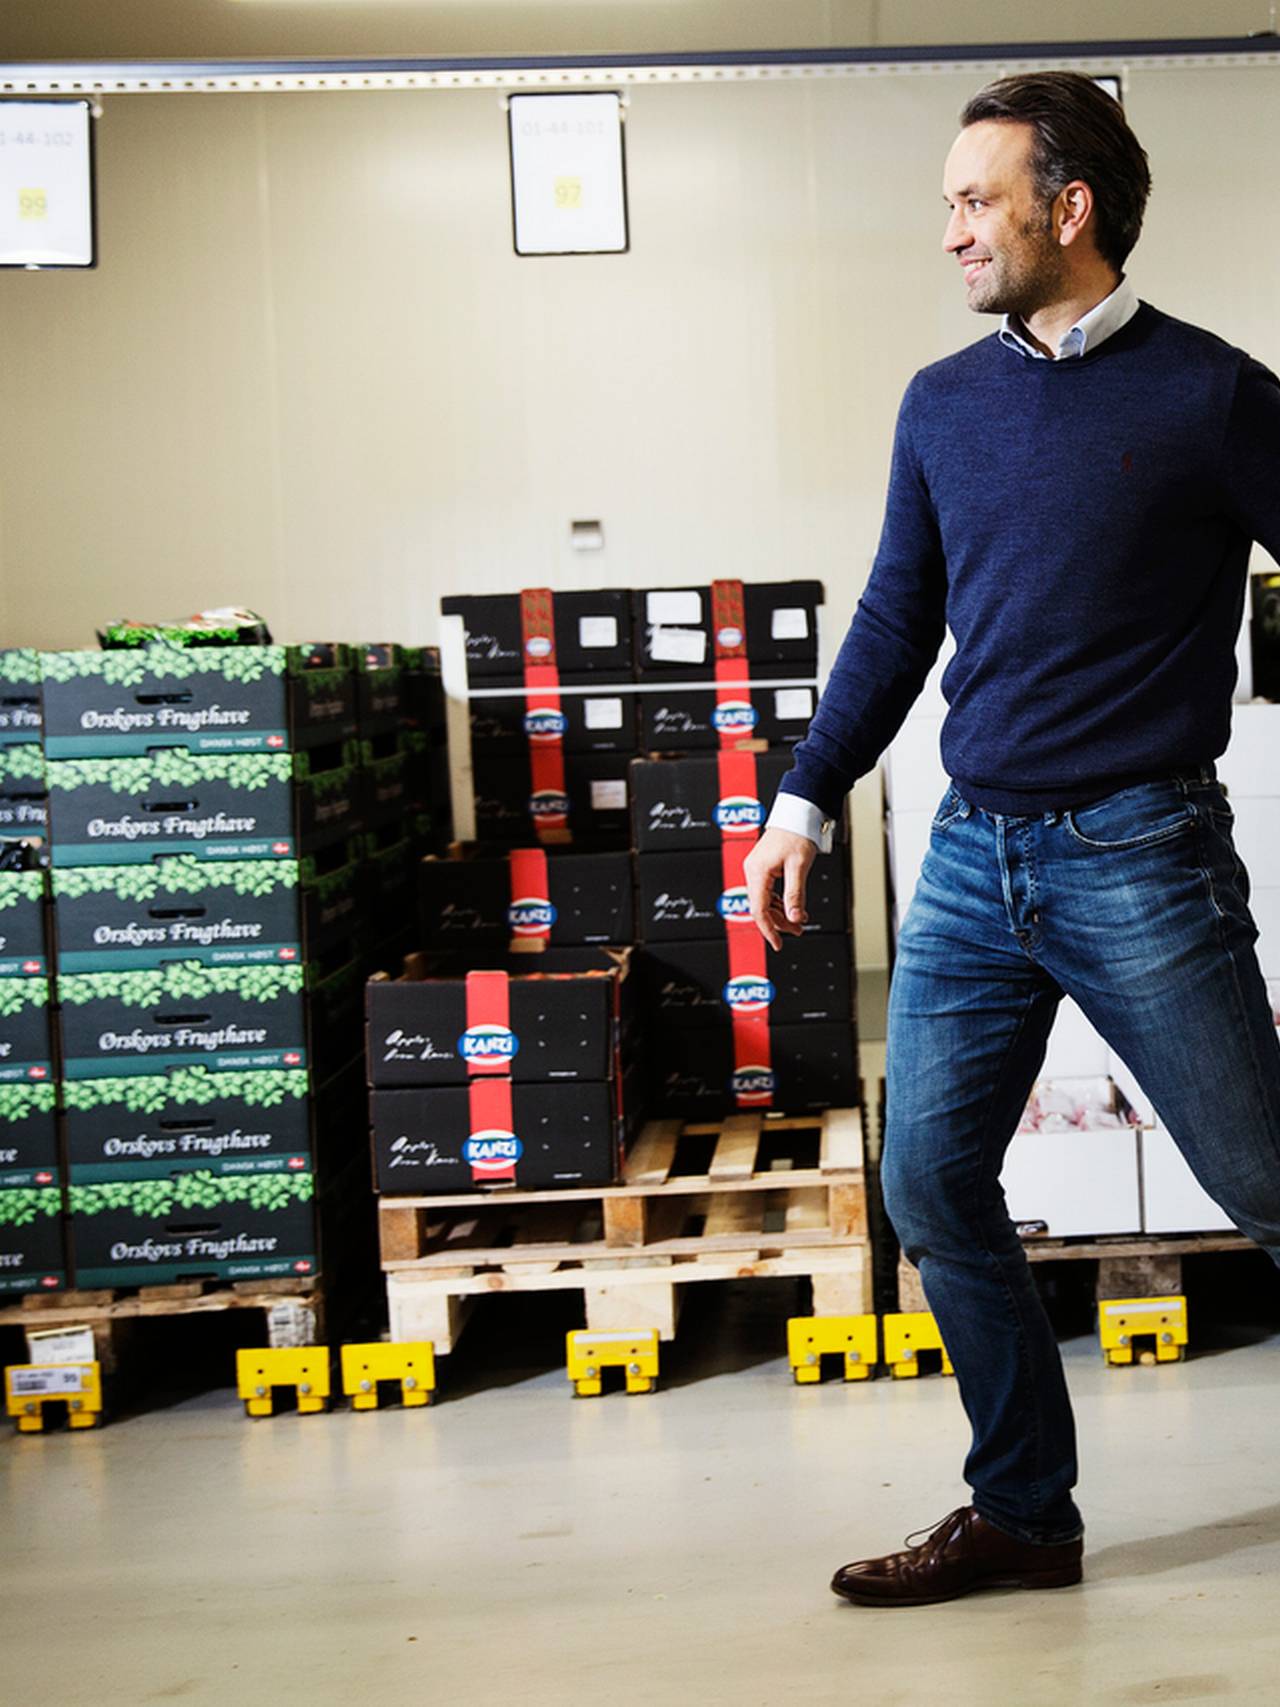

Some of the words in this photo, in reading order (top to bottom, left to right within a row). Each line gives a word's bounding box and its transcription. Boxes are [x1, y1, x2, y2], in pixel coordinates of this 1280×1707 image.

[19, 195, 47, 217] 99
[554, 184, 582, 205] 97
[156, 703, 251, 732] Frugthave
[162, 812, 257, 840] Frugthave
[168, 918, 262, 946] Frugthave
[174, 1024, 267, 1052] Frugthave
[178, 1129, 271, 1157] Frugthave
[185, 1234, 277, 1261] Frugthave
